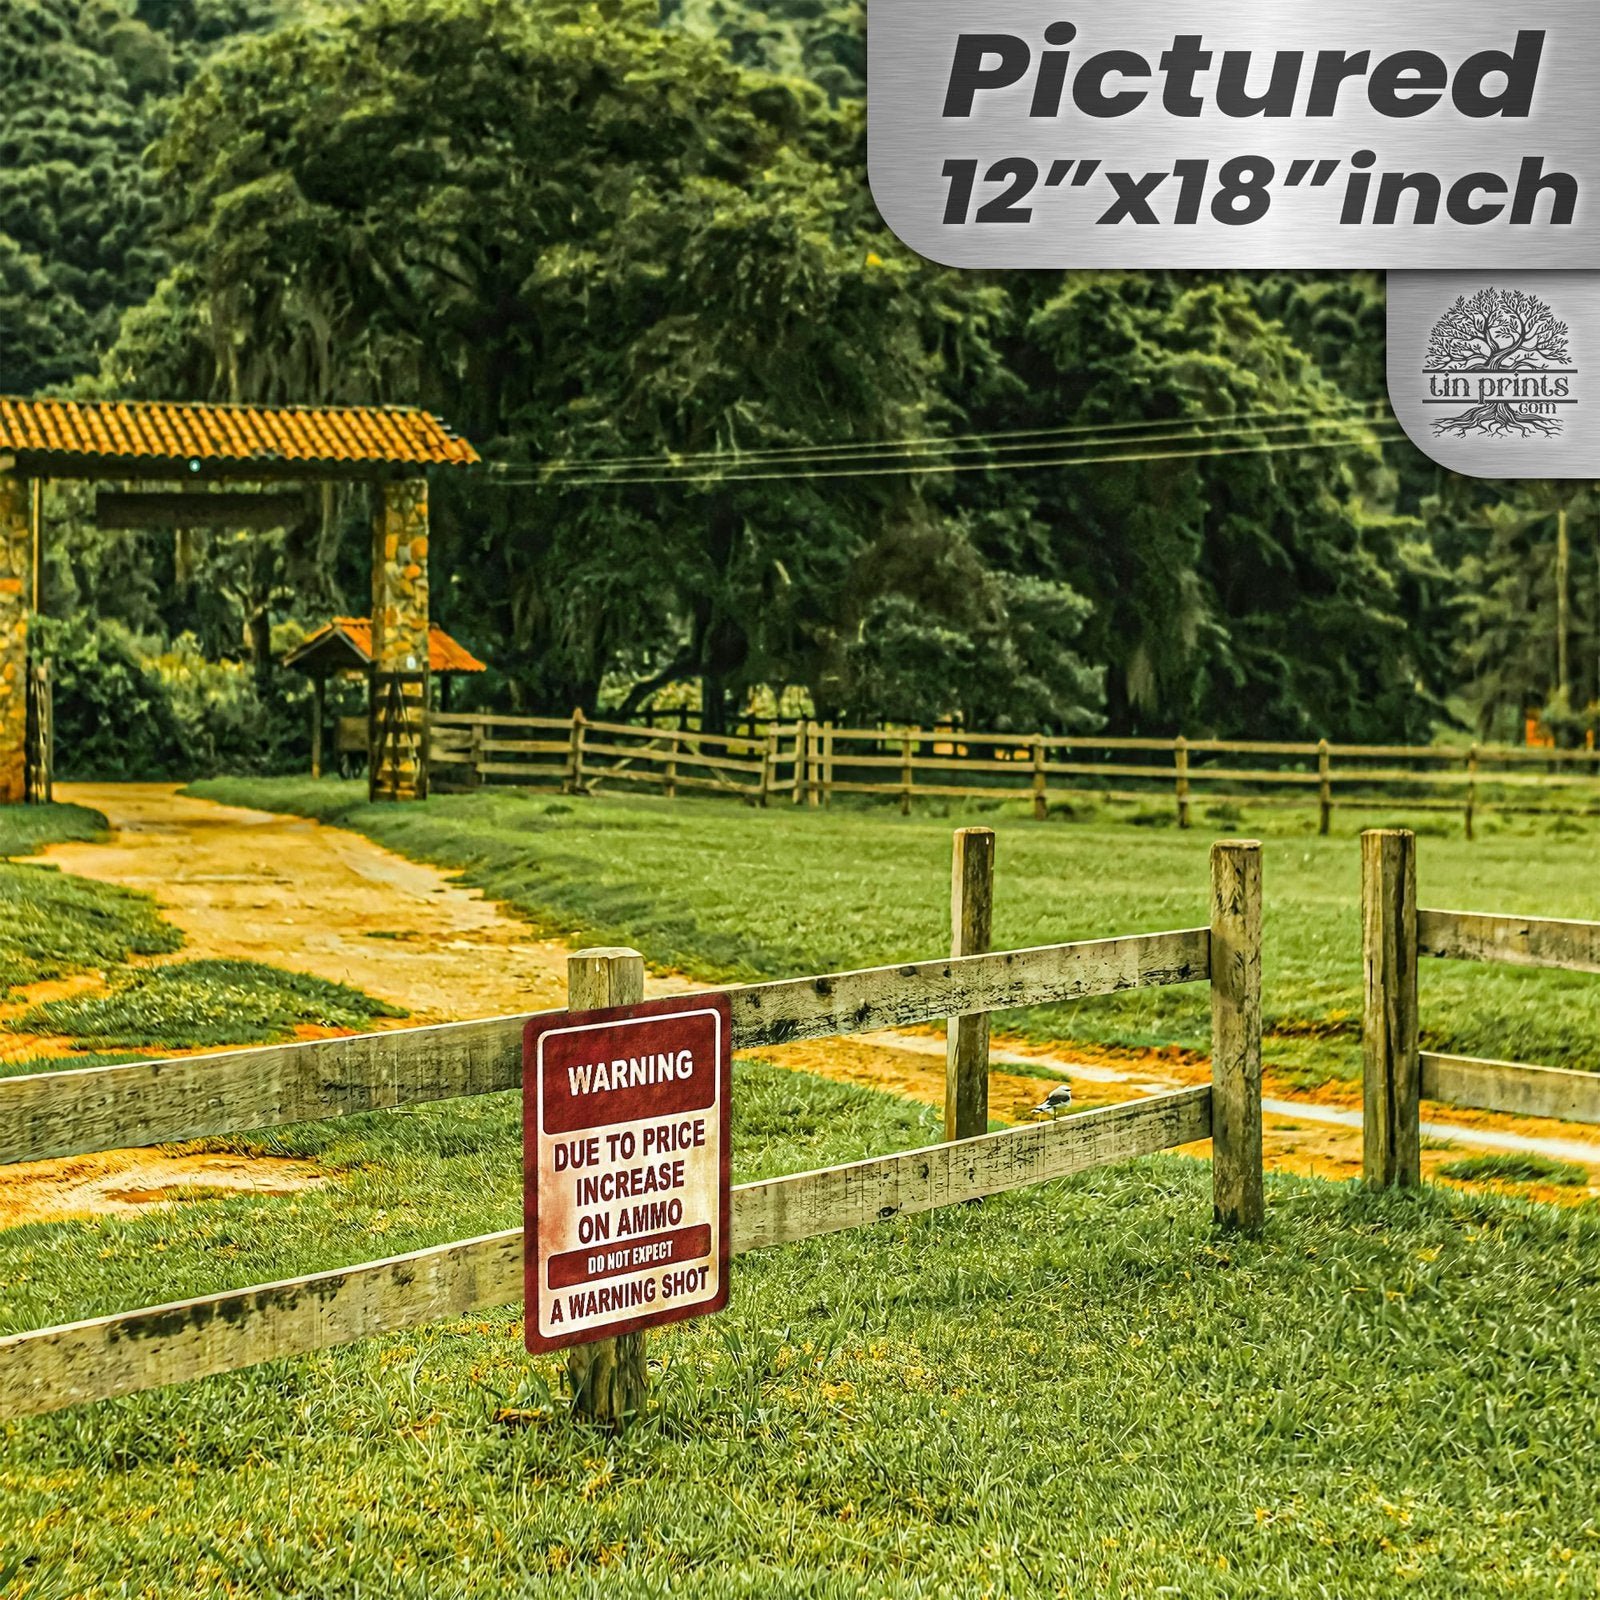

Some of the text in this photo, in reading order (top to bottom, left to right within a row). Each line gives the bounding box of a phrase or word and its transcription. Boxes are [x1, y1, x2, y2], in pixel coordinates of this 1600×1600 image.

[568, 1050, 694, 1097] WARNING
[554, 1119, 706, 1172] DUE TO PRICE
[576, 1160, 685, 1207] INCREASE
[578, 1198, 682, 1244] ON AMMO
[588, 1240, 673, 1275] DO NOT EXPECT
[550, 1266, 709, 1325] A WARNING SHOT
